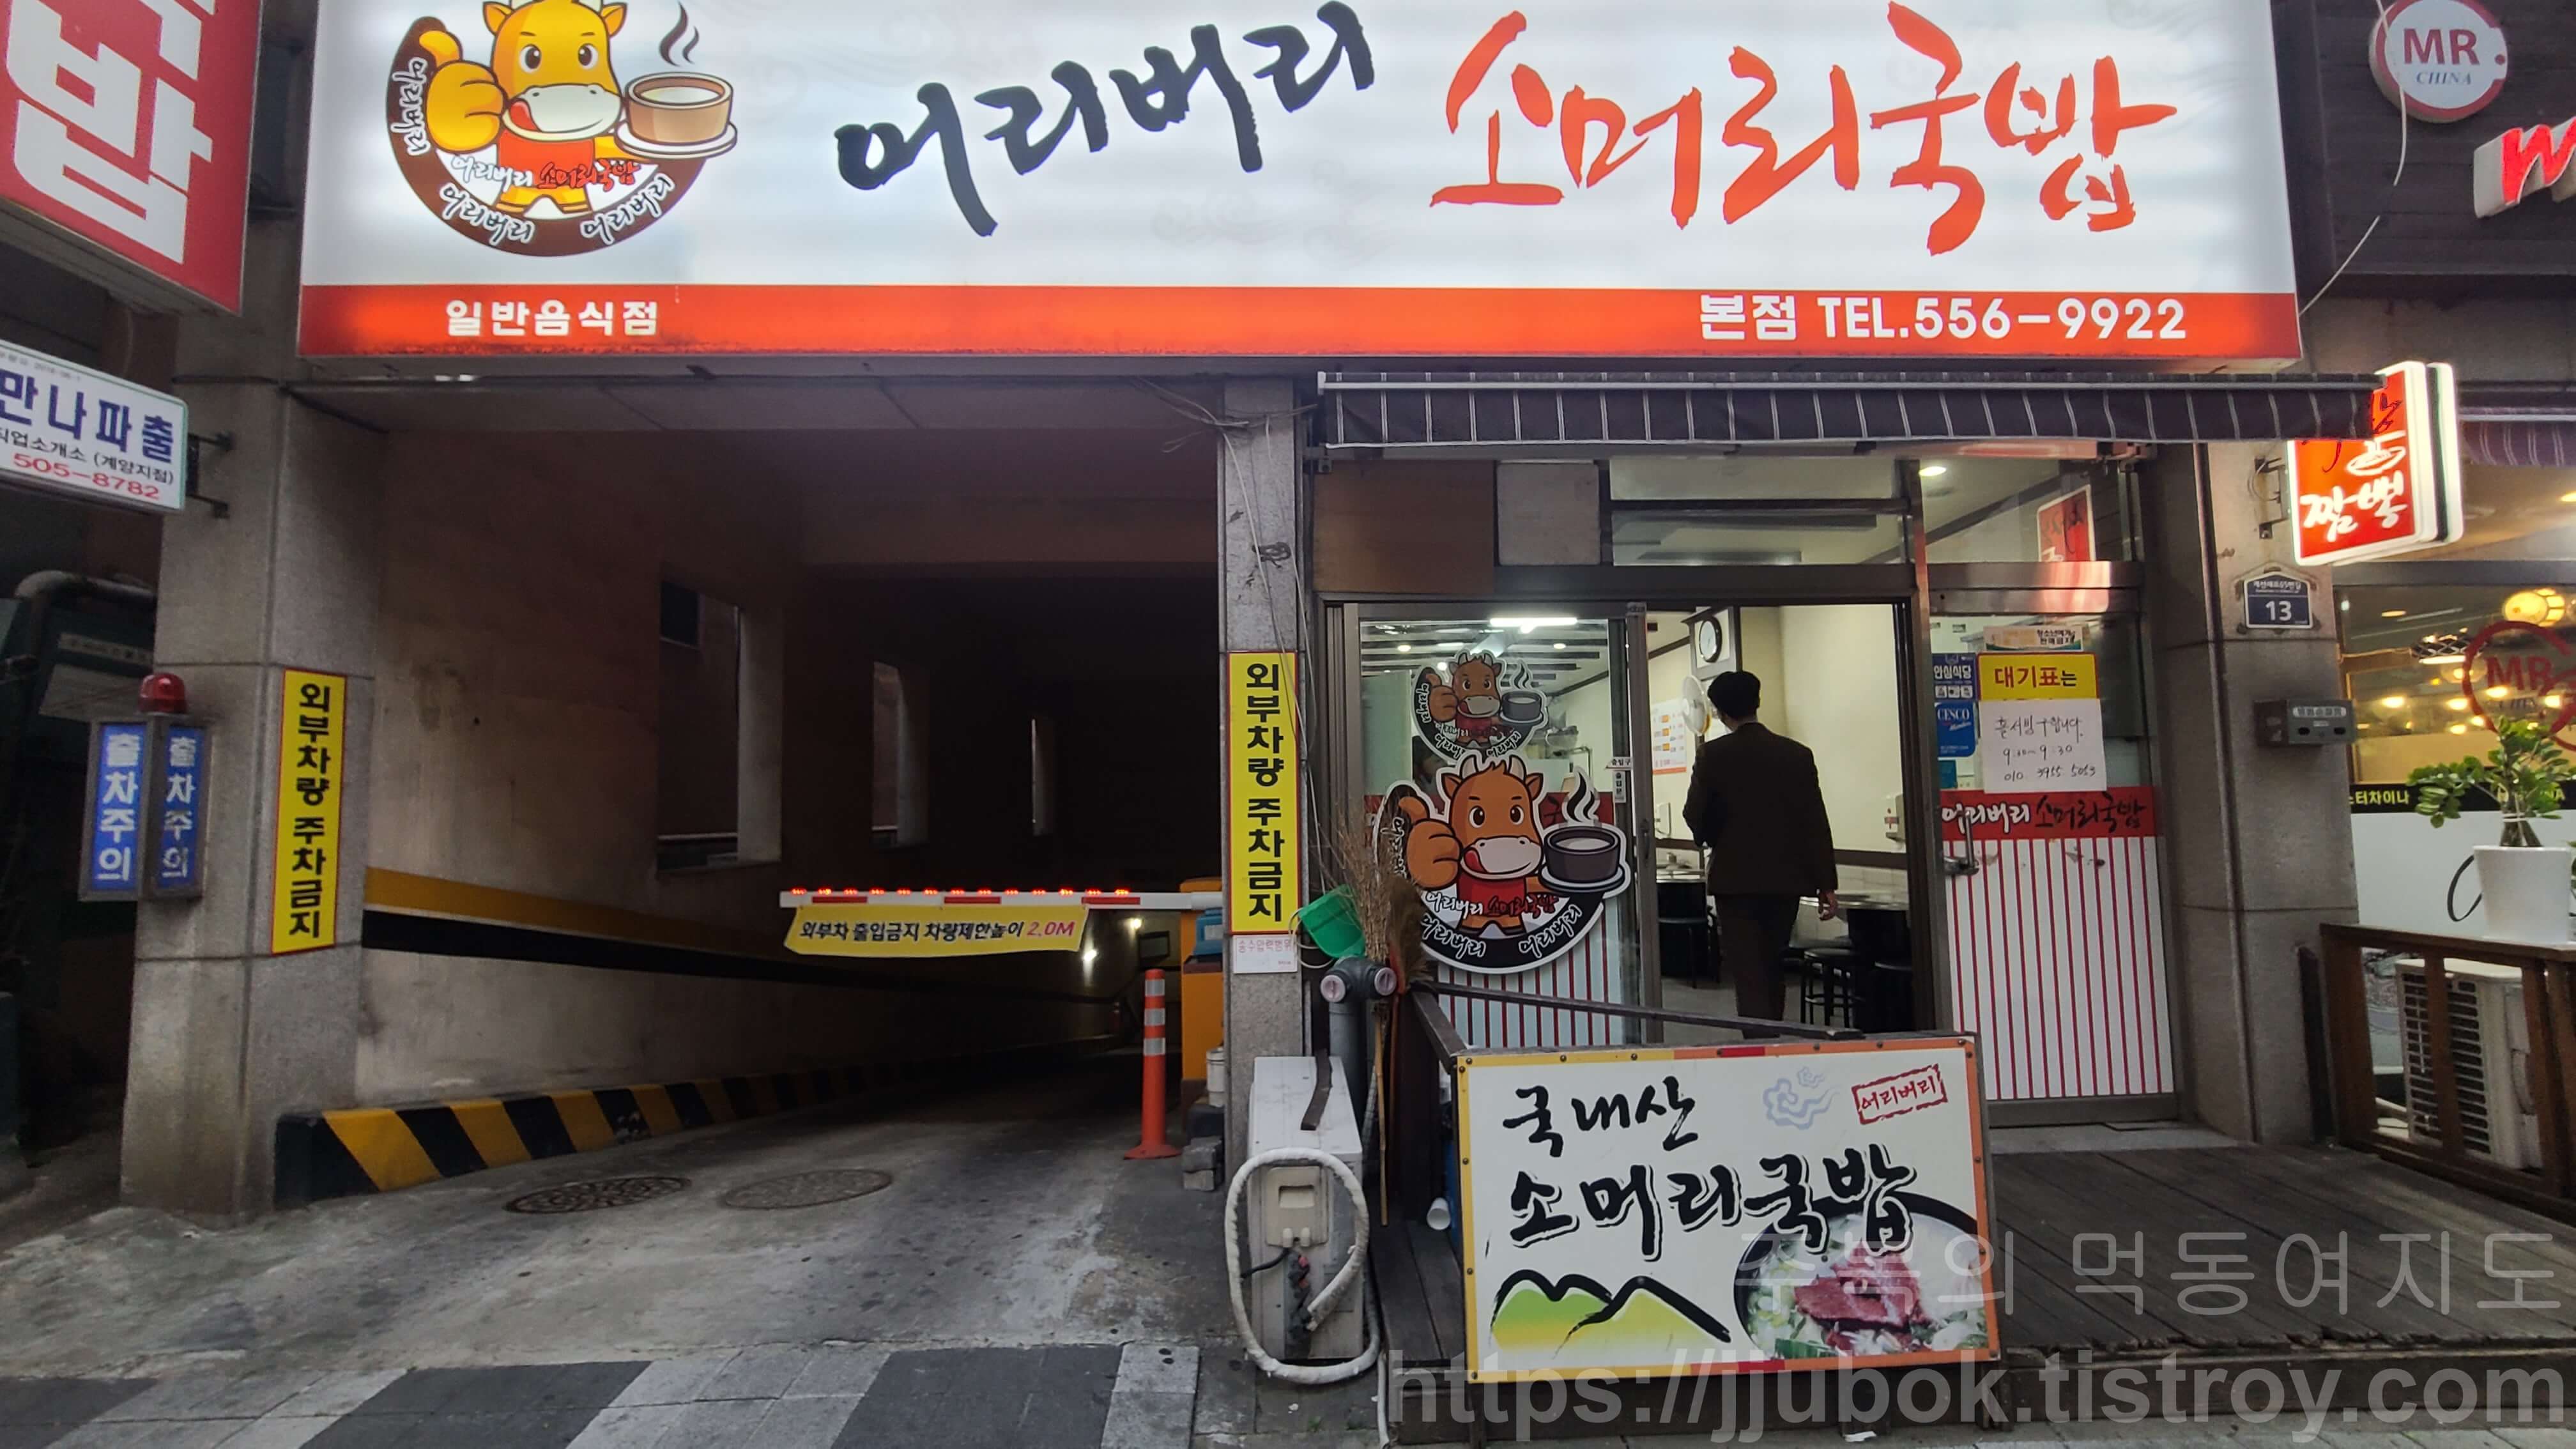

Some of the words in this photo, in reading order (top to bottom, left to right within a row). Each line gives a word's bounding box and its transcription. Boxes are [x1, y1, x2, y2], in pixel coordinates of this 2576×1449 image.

[2403, 28, 2480, 65] MR
[2416, 71, 2472, 86] CHINA
[391, 57, 431, 156] 어리버리
[834, 1, 1375, 236] 어리버리
[1430, 1, 2178, 256] 소머리국밥
[450, 155, 534, 193] 어리버리
[536, 158, 641, 193] 소머리국밥
[440, 183, 535, 245] 어리버리
[580, 173, 675, 244] 어리버리
[446, 299, 658, 336] 일반음식점
[1700, 294, 1797, 341] 본점
[1818, 297, 2186, 339] TEL.556-9922
[13, 452, 160, 501] 505-8782
[2265, 601, 2292, 622] 13
[1934, 665, 1972, 679] 안심식당
[1994, 665, 2077, 689] 대기표는
[1246, 663, 1284, 787] 외부차량
[1937, 708, 1970, 721] CESCO
[295, 682, 331, 806] 외부차량
[2004, 770, 2024, 782] 010
[98, 733, 141, 882] 출차주의
[162, 736, 197, 879] 출차주의
[1942, 802, 2030, 834] 어리버리
[2035, 793, 2147, 832] 소머리국밥
[289, 817, 327, 939] 주차금지
[1247, 798, 1285, 923] 주차금지
[1425, 892, 1483, 919] 어리버리
[800, 921, 848, 941] 외부차
[852, 922, 920, 942] 출입금지
[1027, 921, 1075, 938] 2.0M
[1422, 912, 1487, 959] 어리버리
[1519, 904, 1583, 958] 어리버리
[1860, 1075, 1936, 1110] 어리버리
[1503, 1076, 1698, 1158] 국내산
[1510, 1143, 1918, 1263] 소머리국밥
